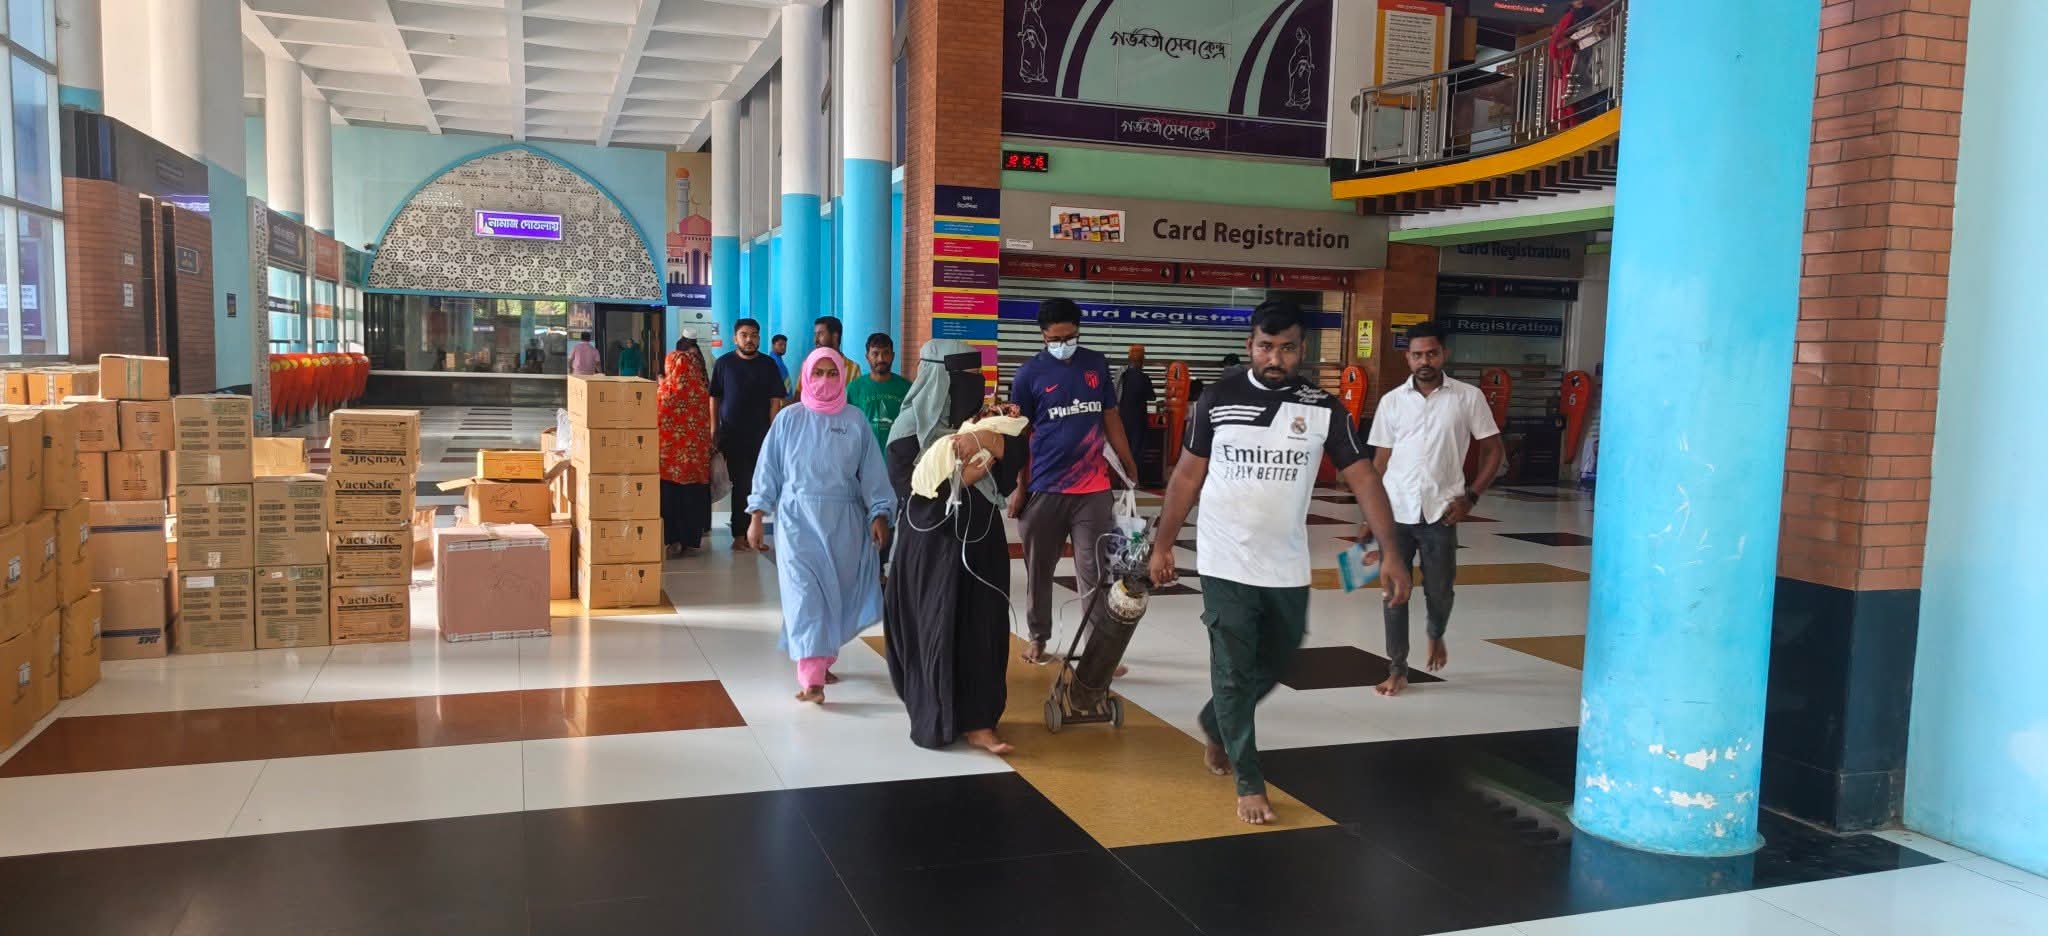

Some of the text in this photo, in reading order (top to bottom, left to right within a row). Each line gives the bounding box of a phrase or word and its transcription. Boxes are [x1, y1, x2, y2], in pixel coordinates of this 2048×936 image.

[1165, 37, 1197, 58] সেবা
[1198, 41, 1230, 59] কেন্দ্র
[1163, 125, 1187, 140] সেবা
[1153, 218, 1350, 249] Card Registration
[1458, 319, 1560, 334] Registration
[1345, 389, 1352, 400] 4
[1568, 393, 1577, 406] 6
[350, 455, 406, 466] VacuSafe
[1223, 444, 1310, 466] Emirates
[1257, 466, 1298, 481] BETTER
[336, 480, 395, 490] VacuSafe
[337, 535, 396, 545] VacuSafe
[338, 594, 397, 605] VacuSafe
